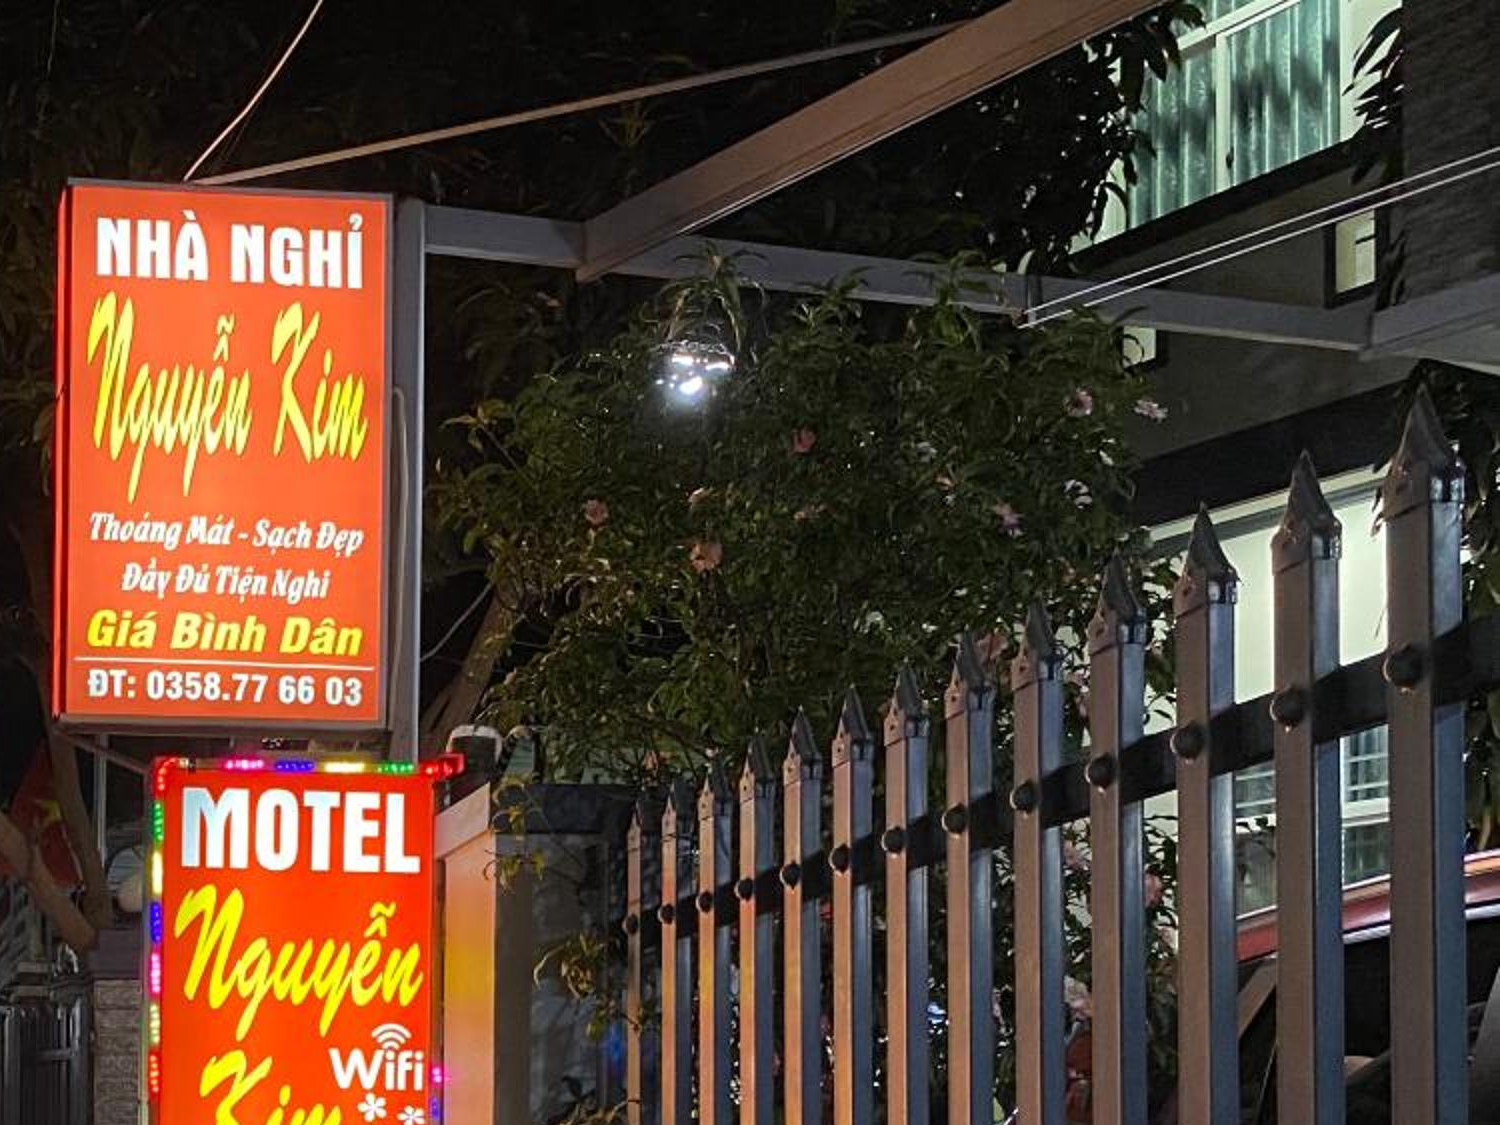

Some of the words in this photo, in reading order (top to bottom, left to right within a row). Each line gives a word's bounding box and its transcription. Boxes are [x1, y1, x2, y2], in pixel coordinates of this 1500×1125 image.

[97, 209, 208, 281] NHÀ
[230, 213, 363, 288] NGHỈ
[87, 290, 252, 504] Nguyễn
[271, 302, 368, 464] Kim
[90, 512, 182, 550] Thoáng
[185, 514, 234, 545] Mát
[253, 519, 312, 554] Sạch
[316, 521, 365, 558] Đẹp
[175, 563, 211, 594] Đủ
[215, 563, 267, 603] Tiện
[87, 609, 157, 648] Giá
[170, 611, 266, 652] Bình
[279, 616, 363, 656] Dân
[87, 668, 137, 699] ĐT:
[146, 668, 269, 703] 0358.77
[278, 674, 315, 705] 66
[324, 676, 362, 707] 03
[181, 787, 421, 874] MOTEL
[175, 884, 424, 1042] Nguyễn
[329, 1048, 424, 1091] Wifi
